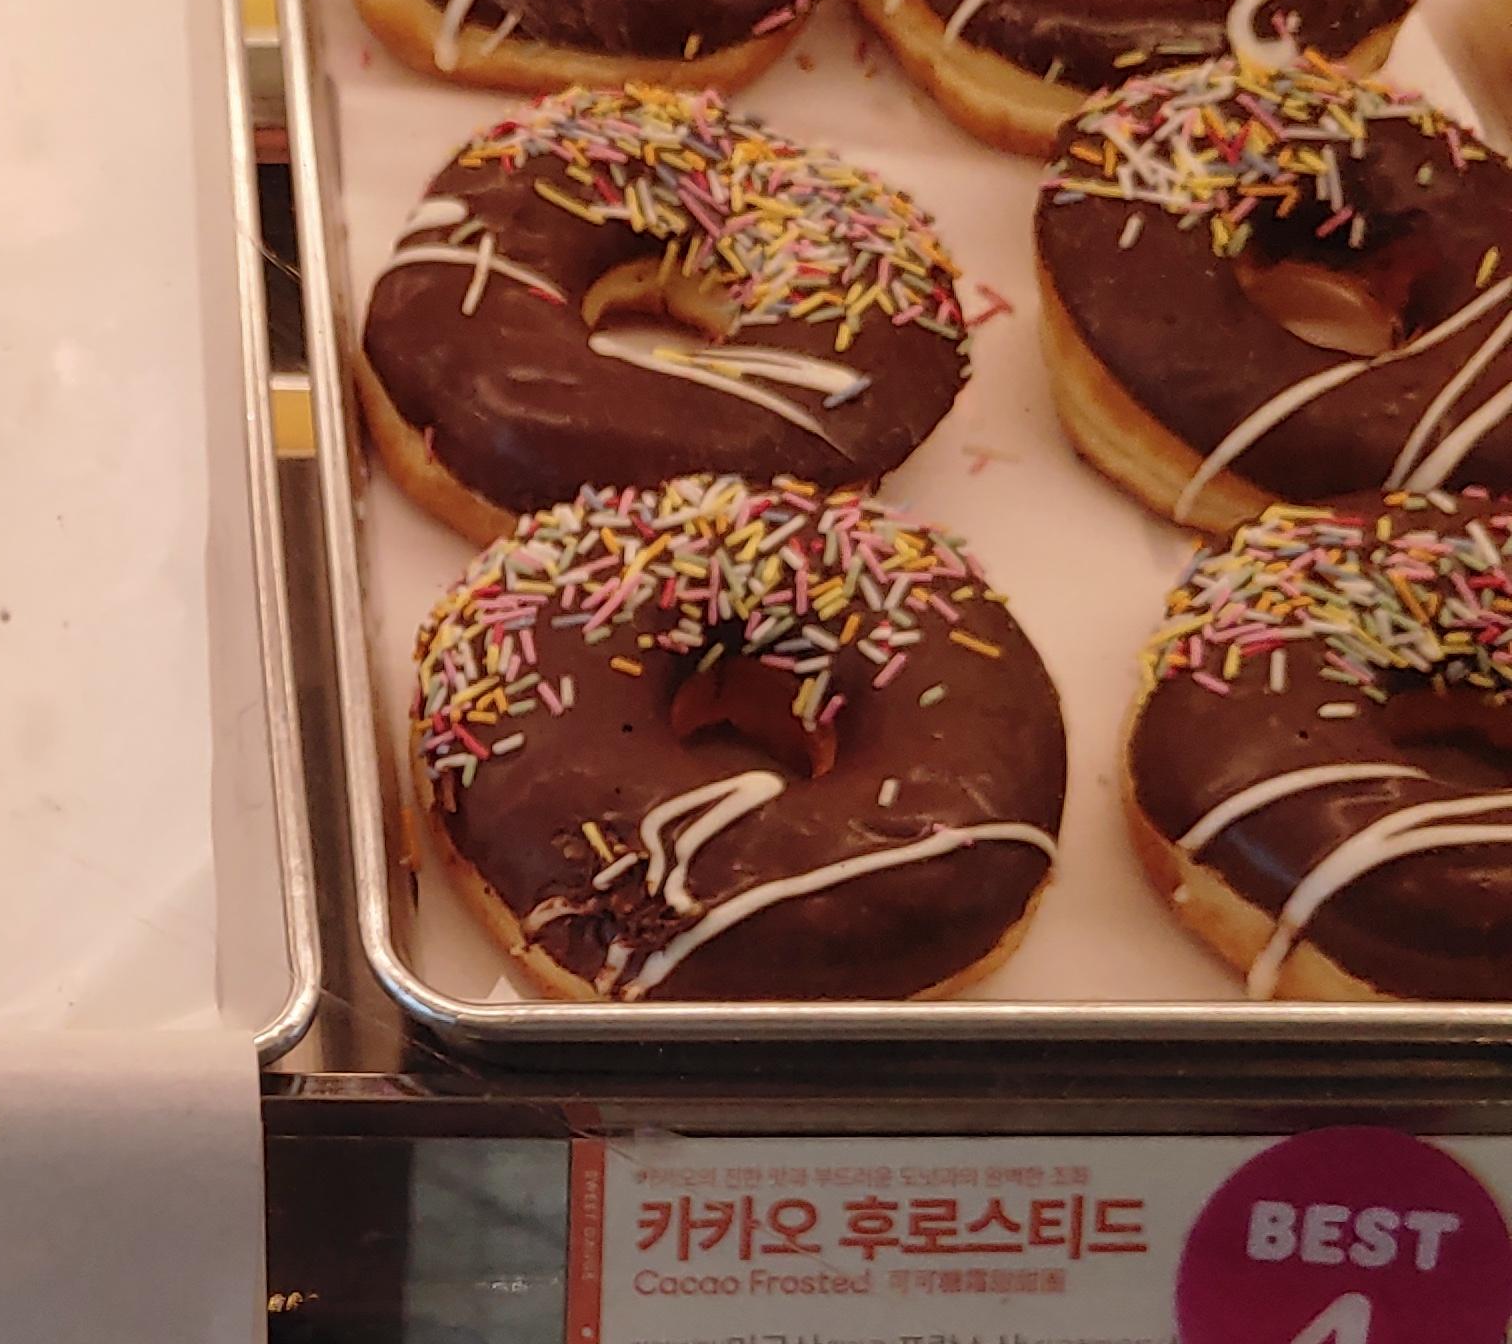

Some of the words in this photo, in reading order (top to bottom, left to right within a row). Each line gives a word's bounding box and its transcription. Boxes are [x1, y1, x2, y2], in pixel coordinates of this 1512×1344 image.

[635, 1194, 822, 1262] 카카오
[838, 1193, 1148, 1262] 후로스티드
[1245, 1199, 1461, 1271] BEST
[632, 1268, 741, 1296] Cacao
[749, 1267, 872, 1295] Frosted
